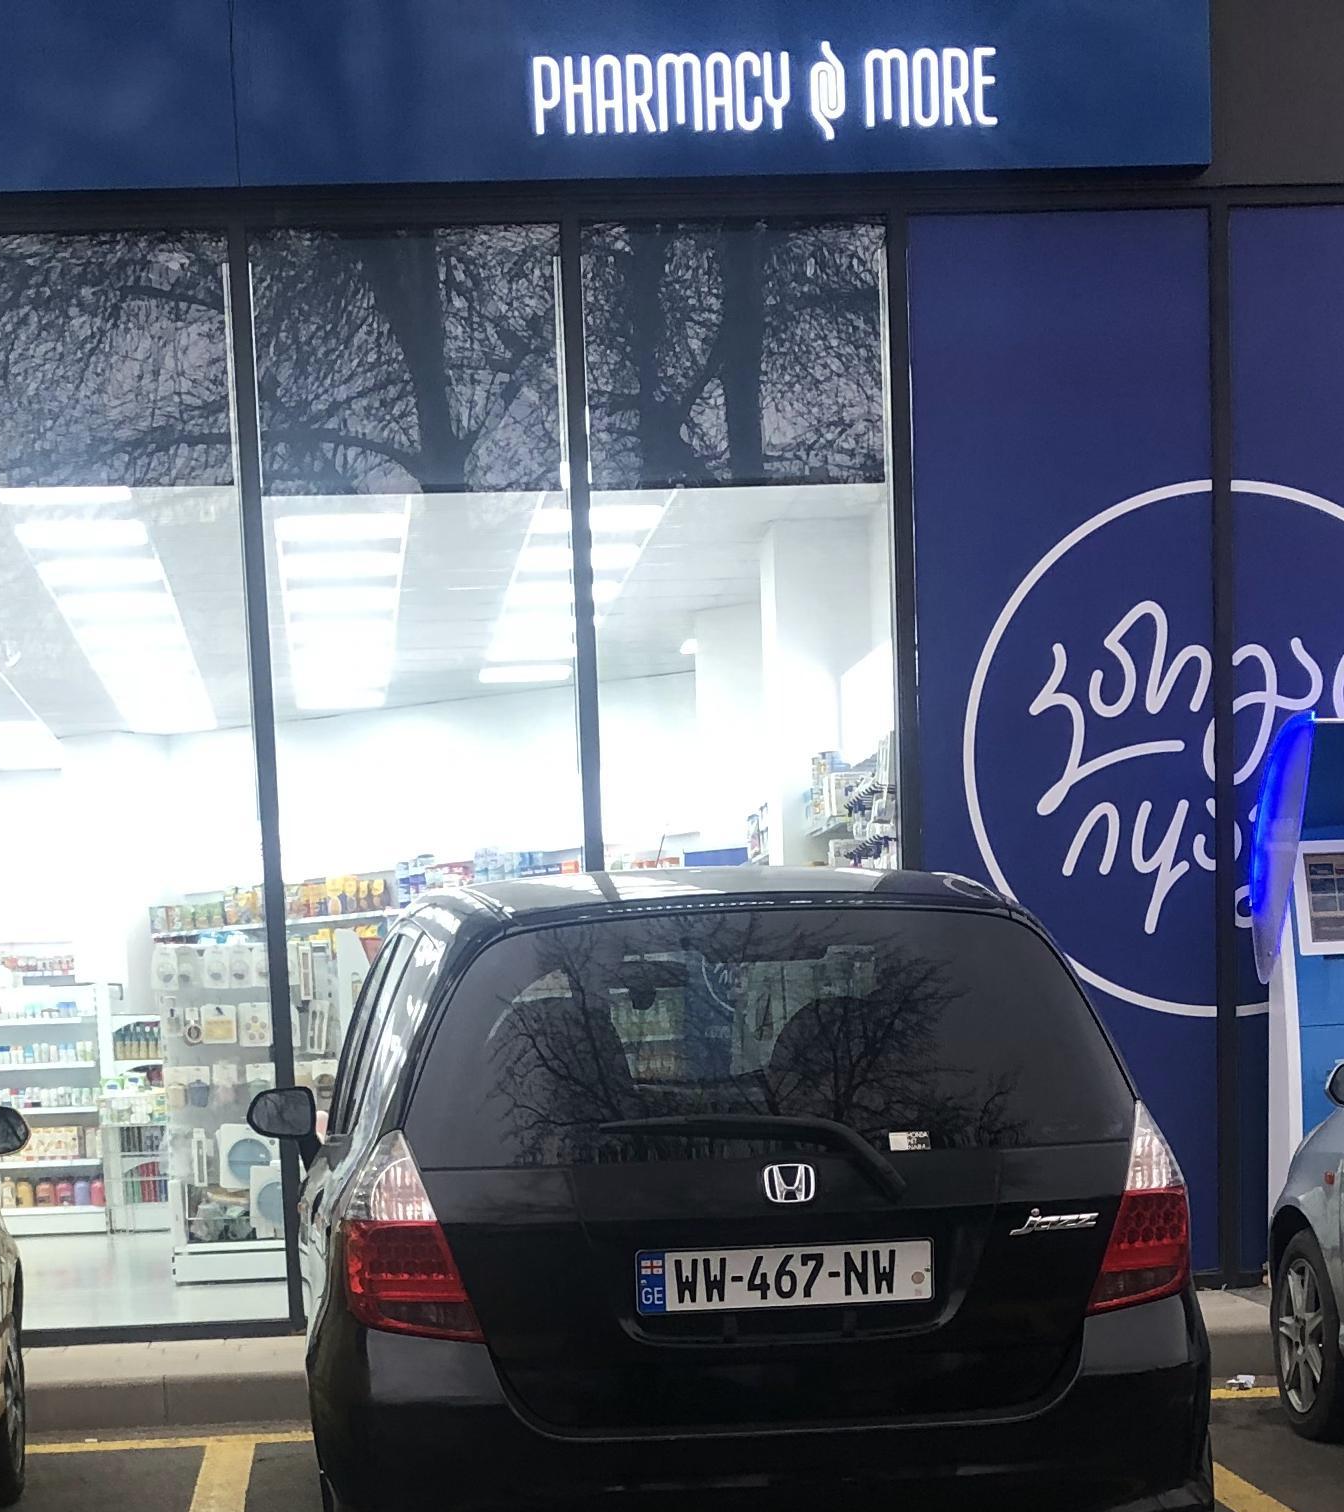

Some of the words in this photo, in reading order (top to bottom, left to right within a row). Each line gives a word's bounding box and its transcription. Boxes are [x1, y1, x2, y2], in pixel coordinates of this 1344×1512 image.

[531, 51, 790, 135] PHARMACY
[864, 46, 997, 128] MORE
[641, 1287, 664, 1305] GE
[674, 1249, 897, 1304] WW-467-NW
